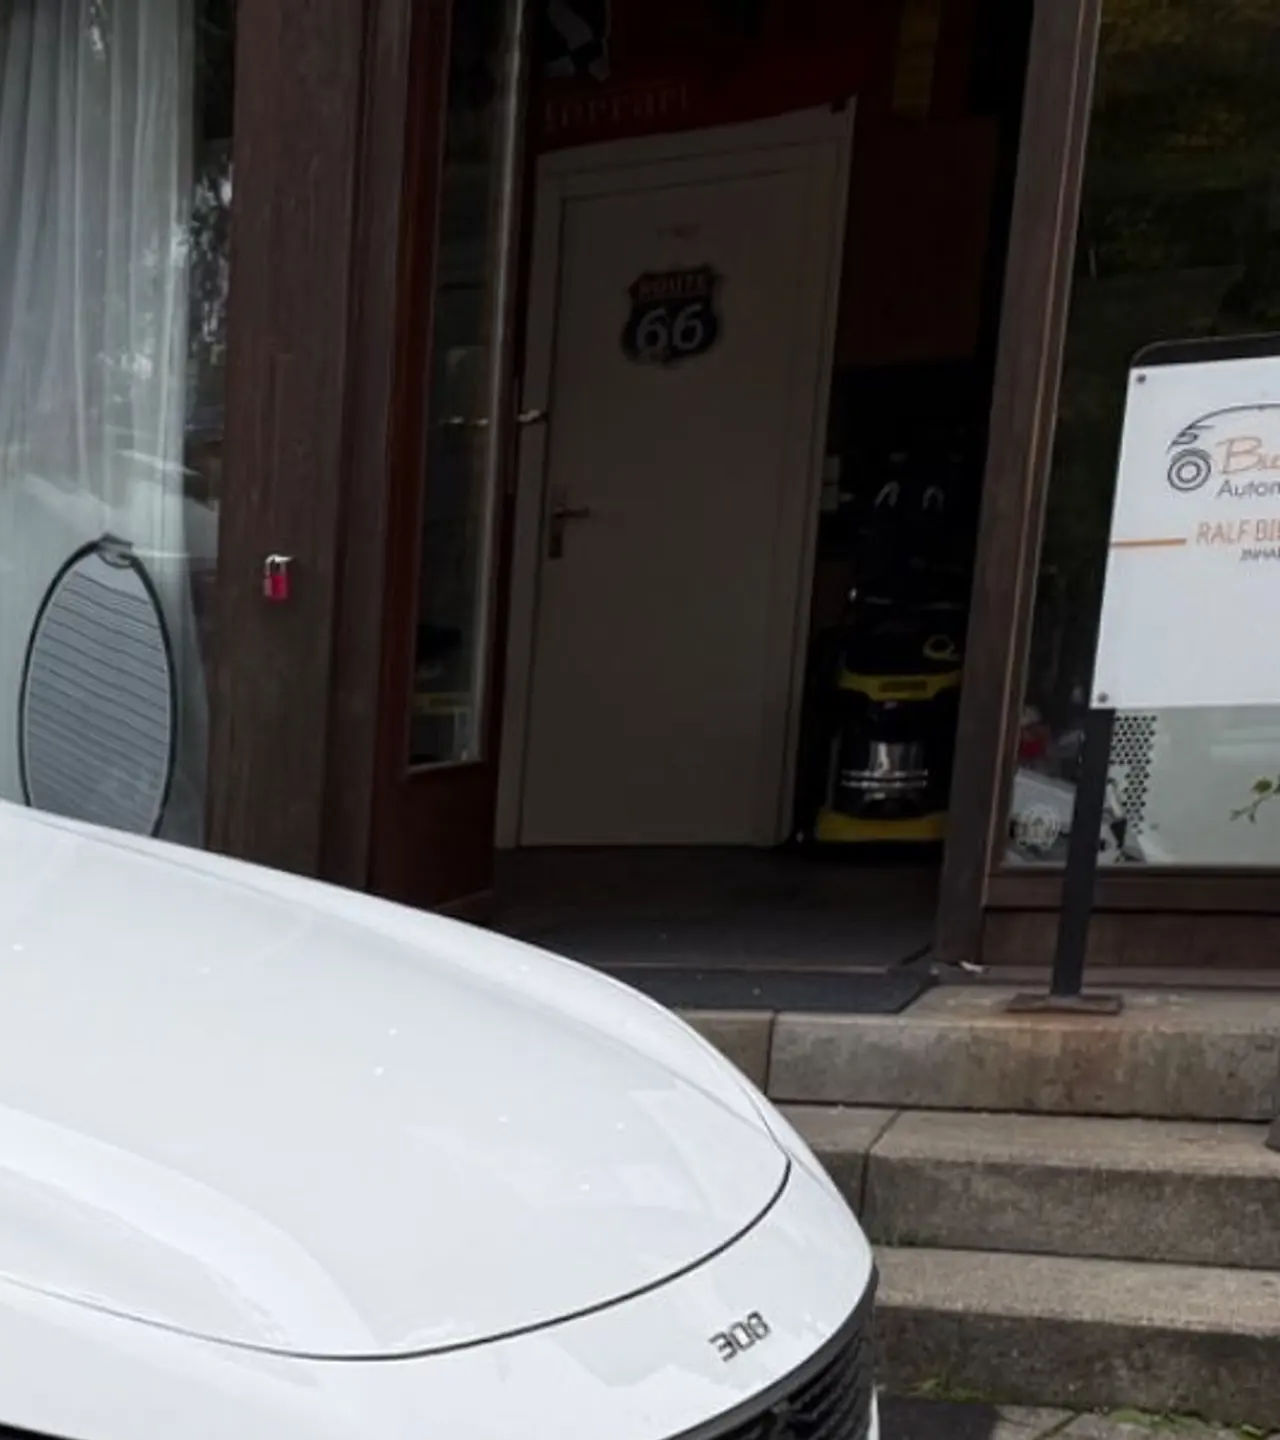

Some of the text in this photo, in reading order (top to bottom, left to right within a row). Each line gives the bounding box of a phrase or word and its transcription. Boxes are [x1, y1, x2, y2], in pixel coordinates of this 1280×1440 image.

[635, 302, 704, 355] 66
[1196, 519, 1252, 546] RALF
[708, 1310, 772, 1362] 308
